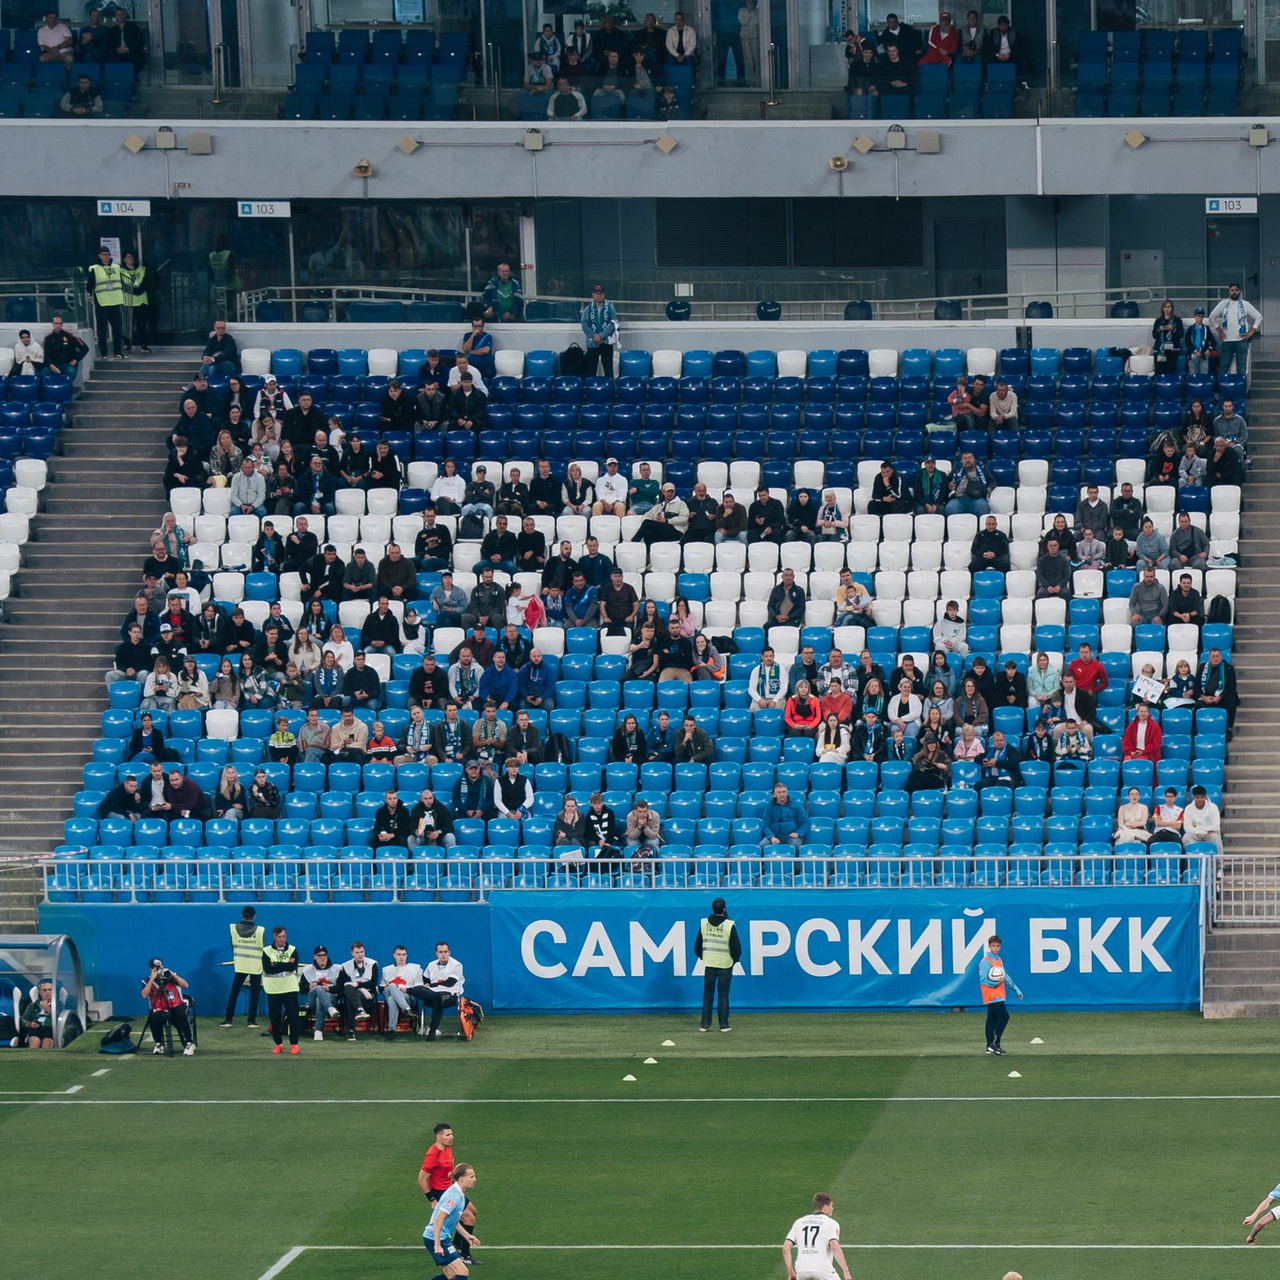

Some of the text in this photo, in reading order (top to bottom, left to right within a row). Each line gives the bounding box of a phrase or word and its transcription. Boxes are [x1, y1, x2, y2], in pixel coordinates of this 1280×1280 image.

[116, 203, 134, 213] 104
[256, 204, 274, 214] 103
[1224, 200, 1242, 210] 103
[1029, 915, 1172, 974] БКК
[802, 1225, 820, 1247] 17
